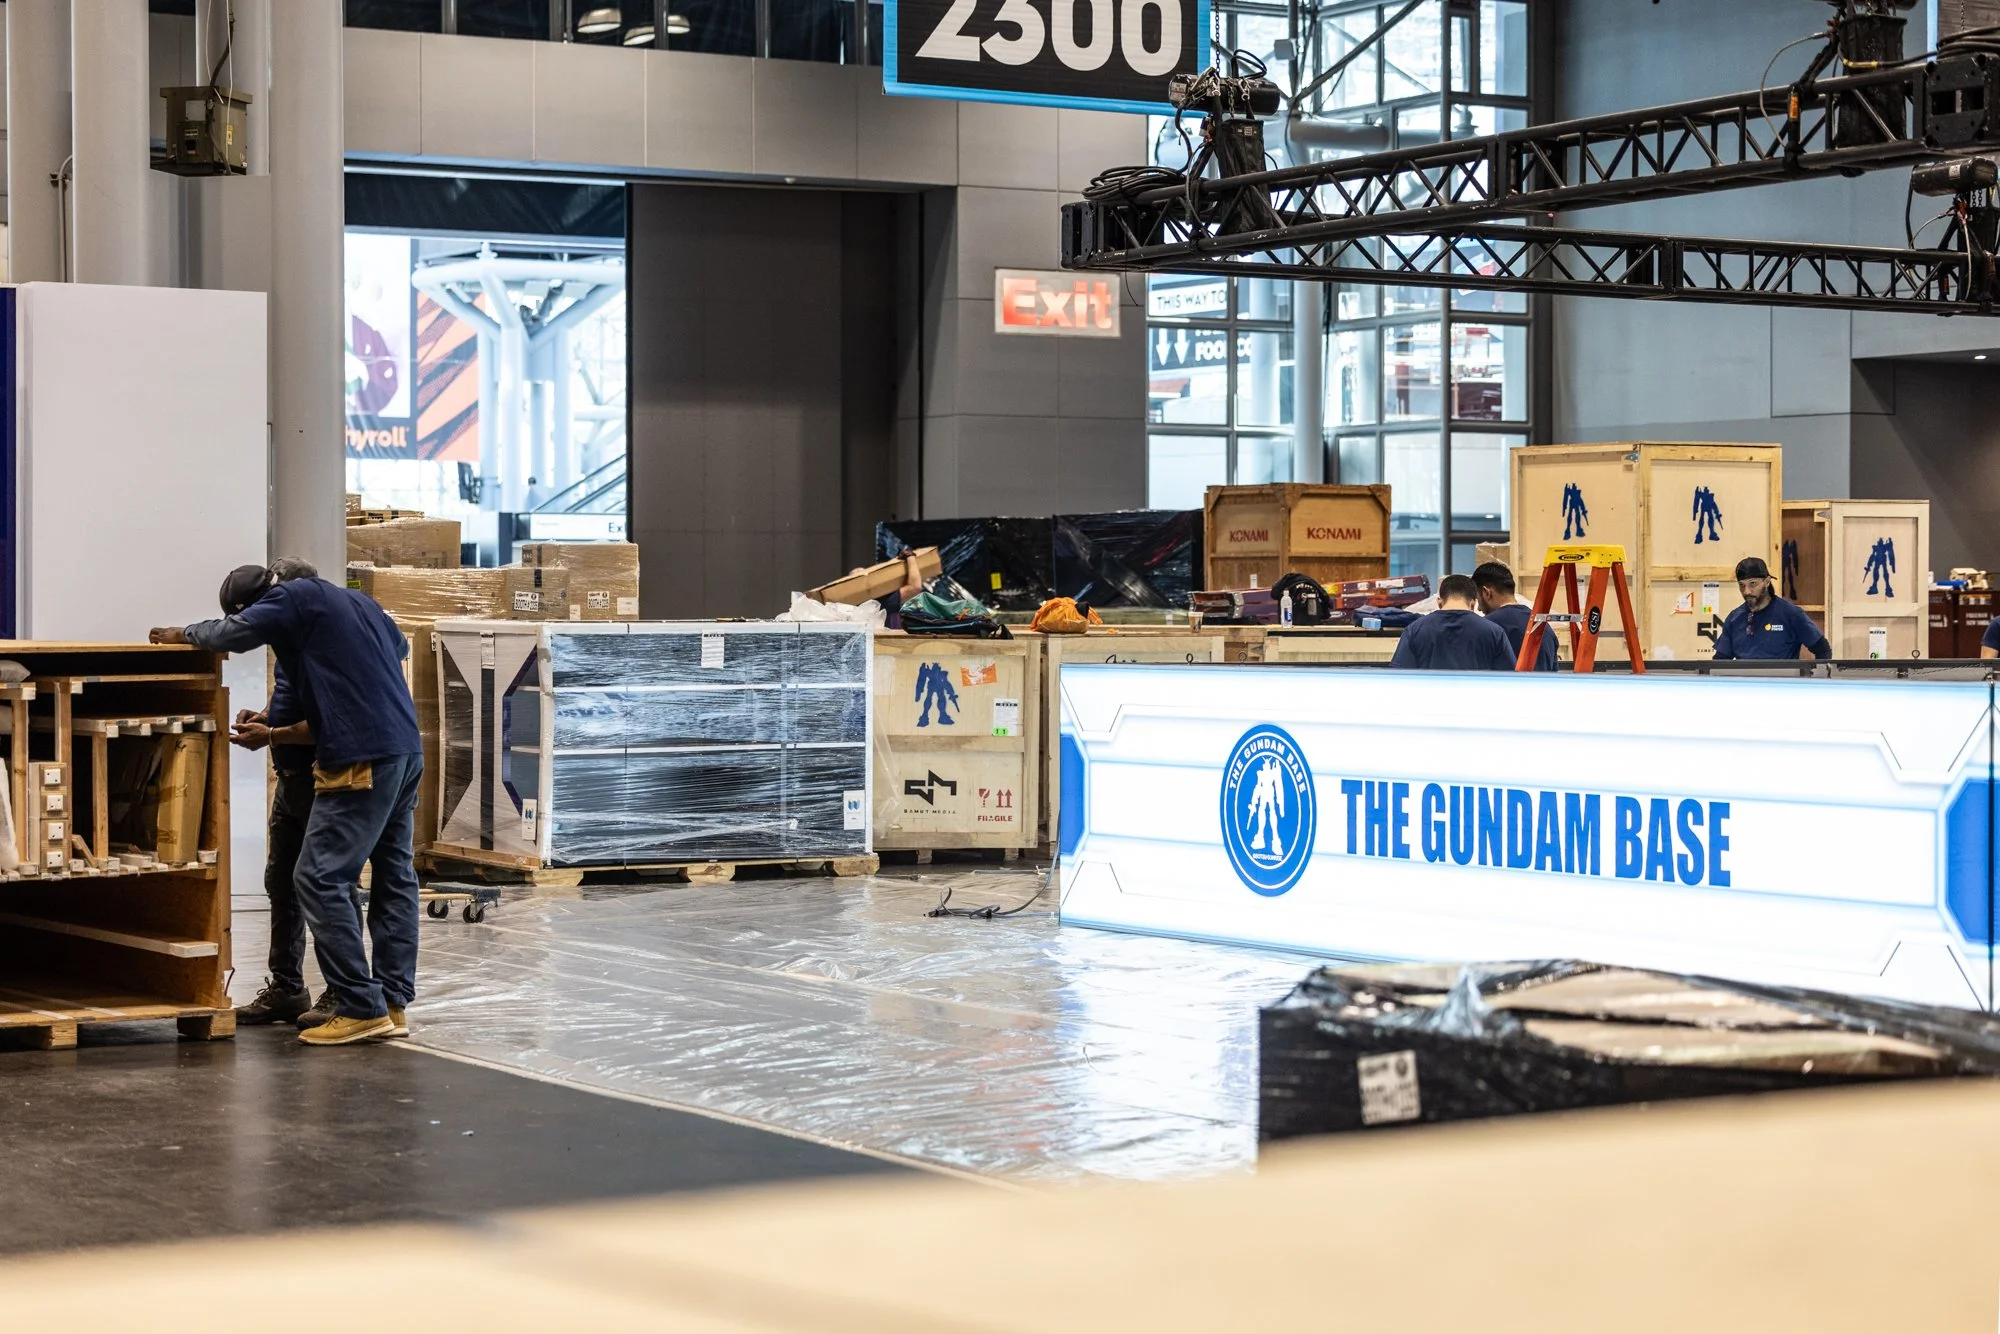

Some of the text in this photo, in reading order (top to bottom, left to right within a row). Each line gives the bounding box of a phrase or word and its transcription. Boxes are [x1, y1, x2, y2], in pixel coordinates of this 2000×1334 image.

[915, 0, 1182, 76] 2300
[1002, 278, 1112, 329] Exit
[1157, 289, 1227, 309] THIS WAY TO
[1229, 529, 1269, 542] KONAMI
[1307, 527, 1361, 540] KONAMI
[1229, 738, 1307, 793] THE GUNDAM BASE
[1341, 779, 1731, 887] THE GUNDAM BASE
